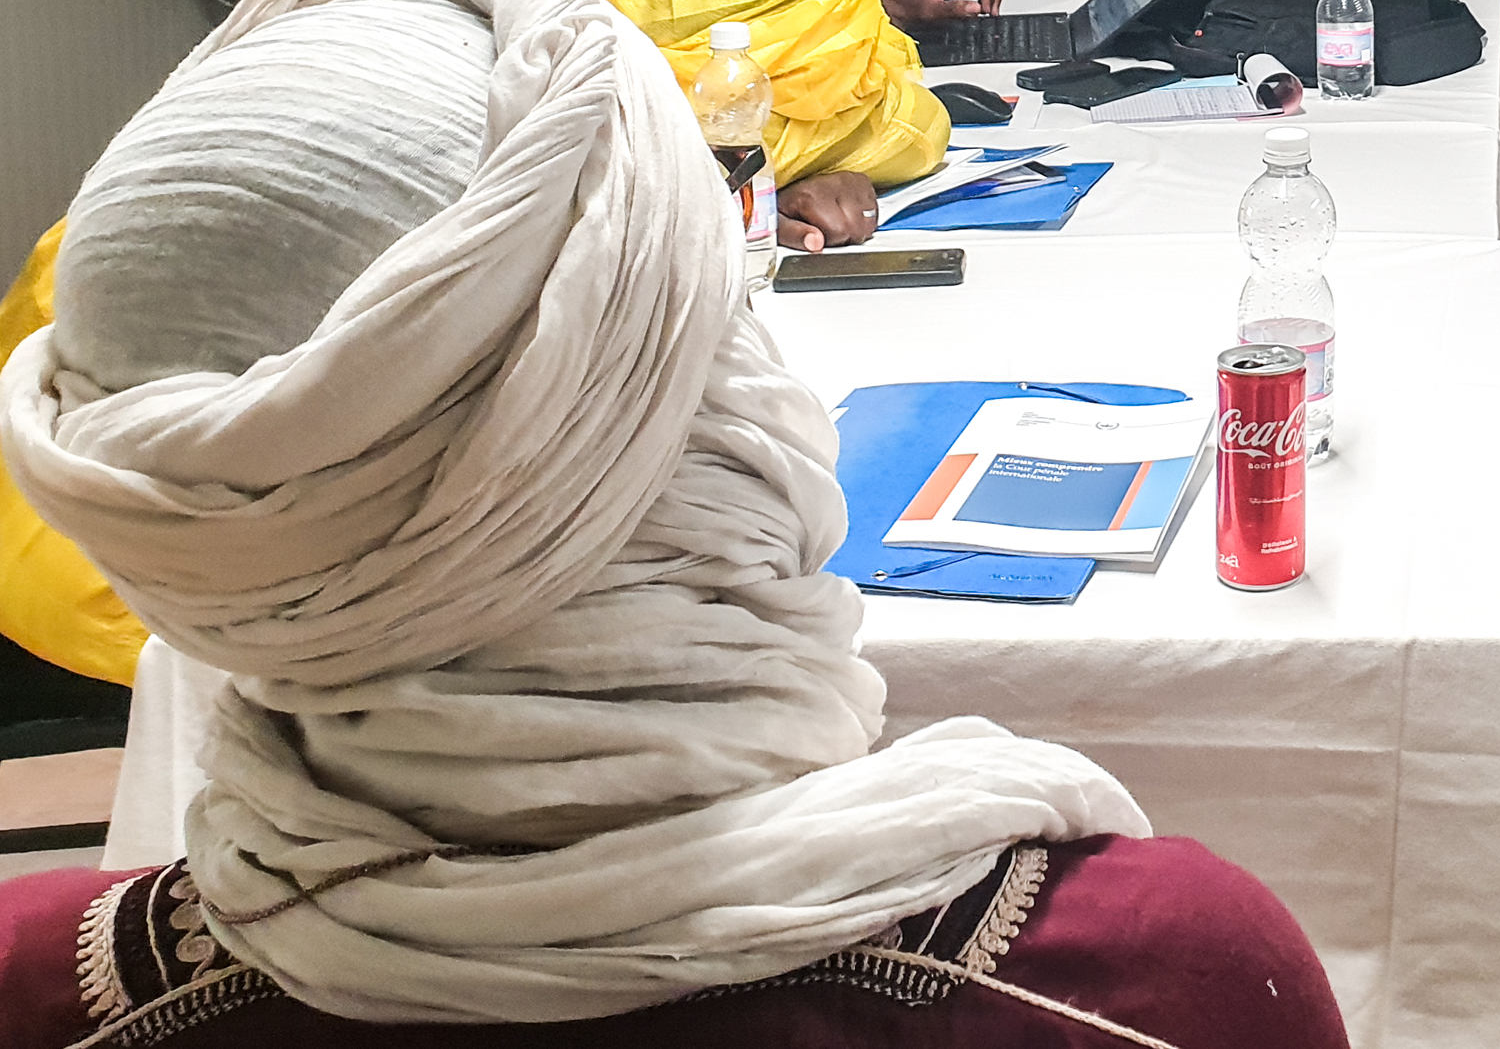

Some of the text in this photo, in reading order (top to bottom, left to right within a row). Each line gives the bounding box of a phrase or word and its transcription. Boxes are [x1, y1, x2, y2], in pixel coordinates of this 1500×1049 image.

[1219, 400, 1306, 458] Coca-Co
[997, 456, 1104, 472] Mieux comprendre
[1005, 463, 1033, 472] Cour
[988, 469, 1063, 483] internationale
